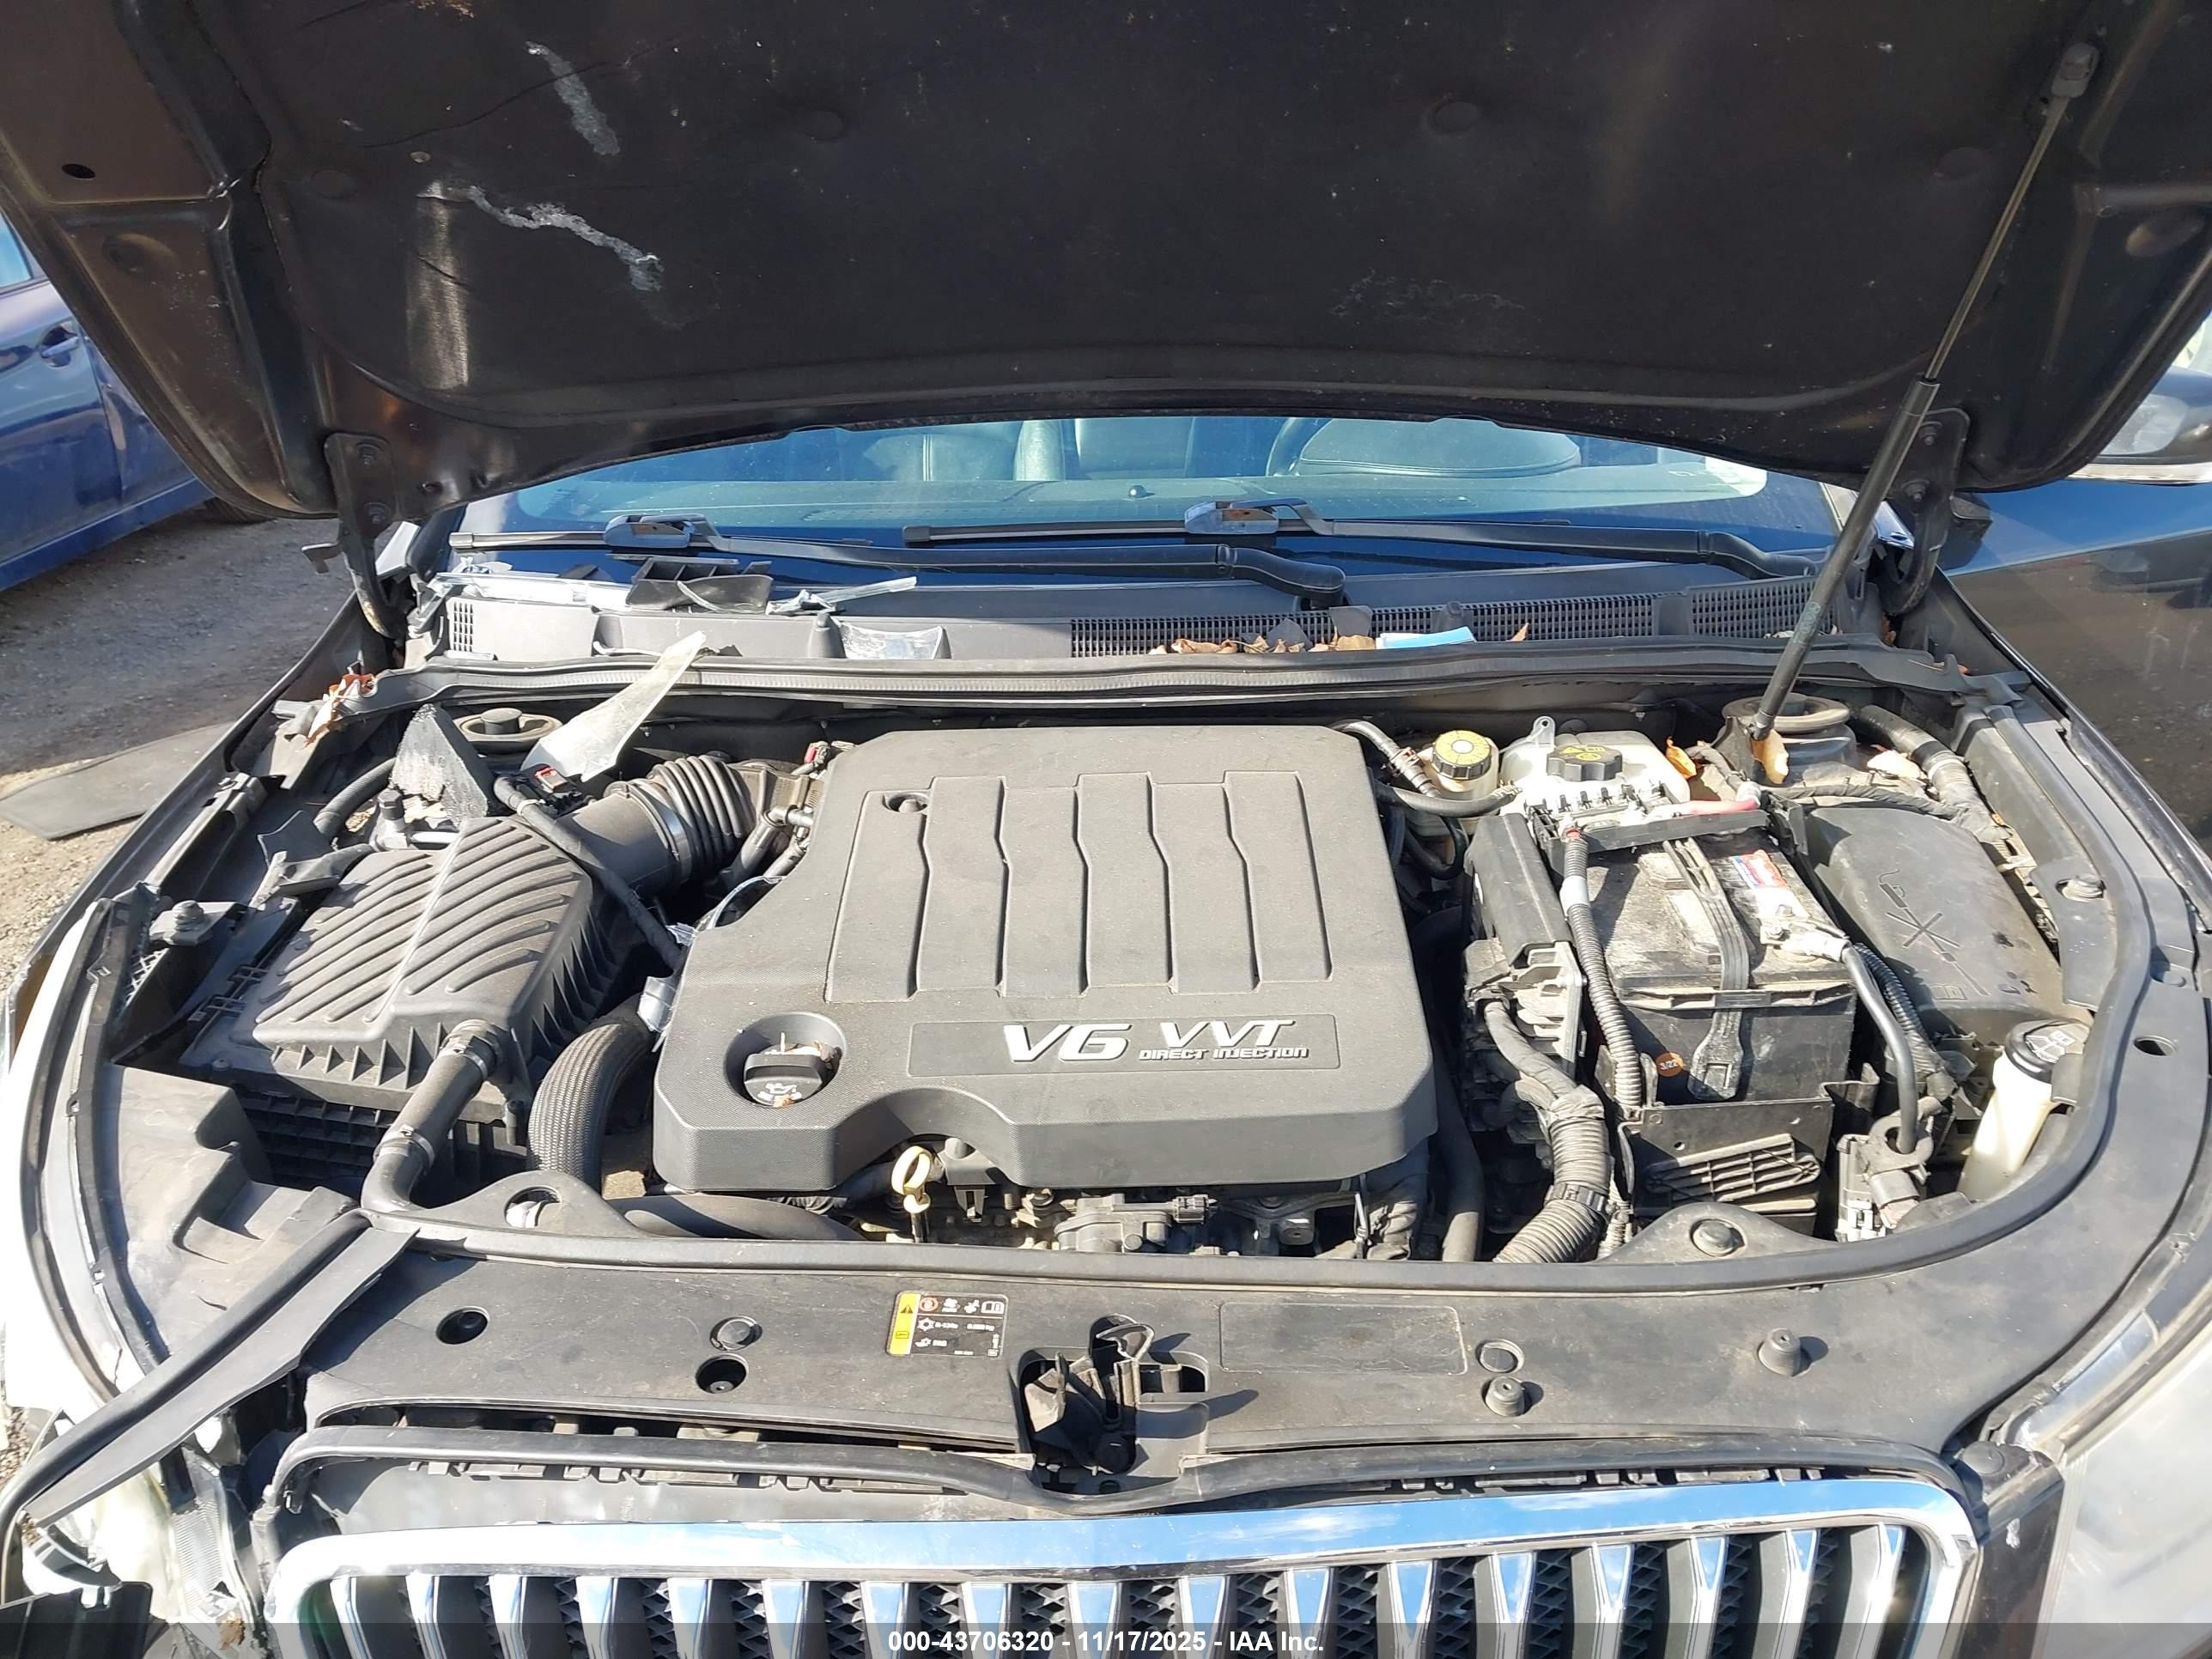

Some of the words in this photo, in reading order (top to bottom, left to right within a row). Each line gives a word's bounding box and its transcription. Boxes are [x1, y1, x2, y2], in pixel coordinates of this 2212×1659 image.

[1004, 1023, 1133, 1063] V6
[1159, 1019, 1295, 1048] VVT
[1138, 1048, 1210, 1060] DIRECT
[1212, 1047, 1310, 1060] INJECTION
